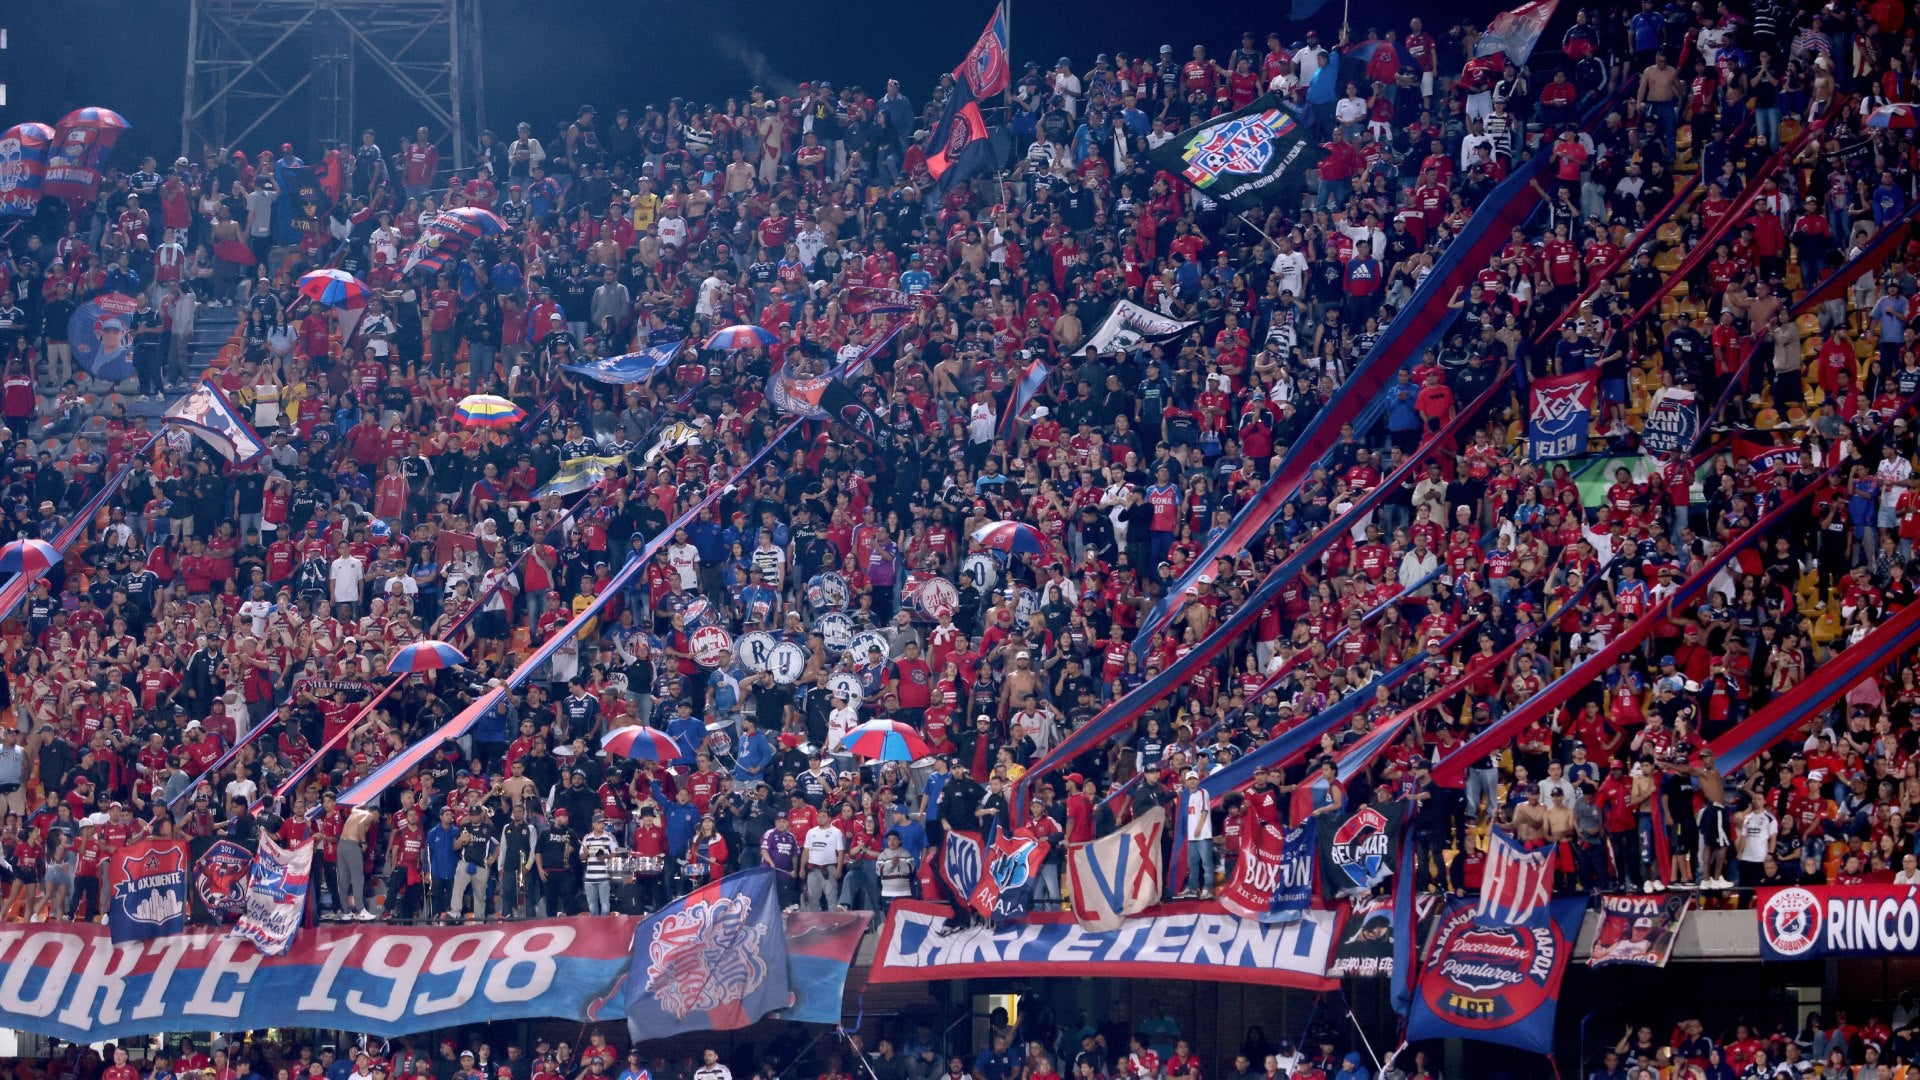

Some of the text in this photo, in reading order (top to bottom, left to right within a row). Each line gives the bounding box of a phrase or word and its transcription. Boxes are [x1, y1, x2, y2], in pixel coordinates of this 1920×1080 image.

[1153, 504, 1163, 514] 10
[512, 543, 522, 553] 91
[1047, 910, 1338, 976] ETERNO
[1451, 939, 1530, 960] Decoramox
[297, 925, 577, 1023] 1998
[1440, 959, 1524, 983] Popularex
